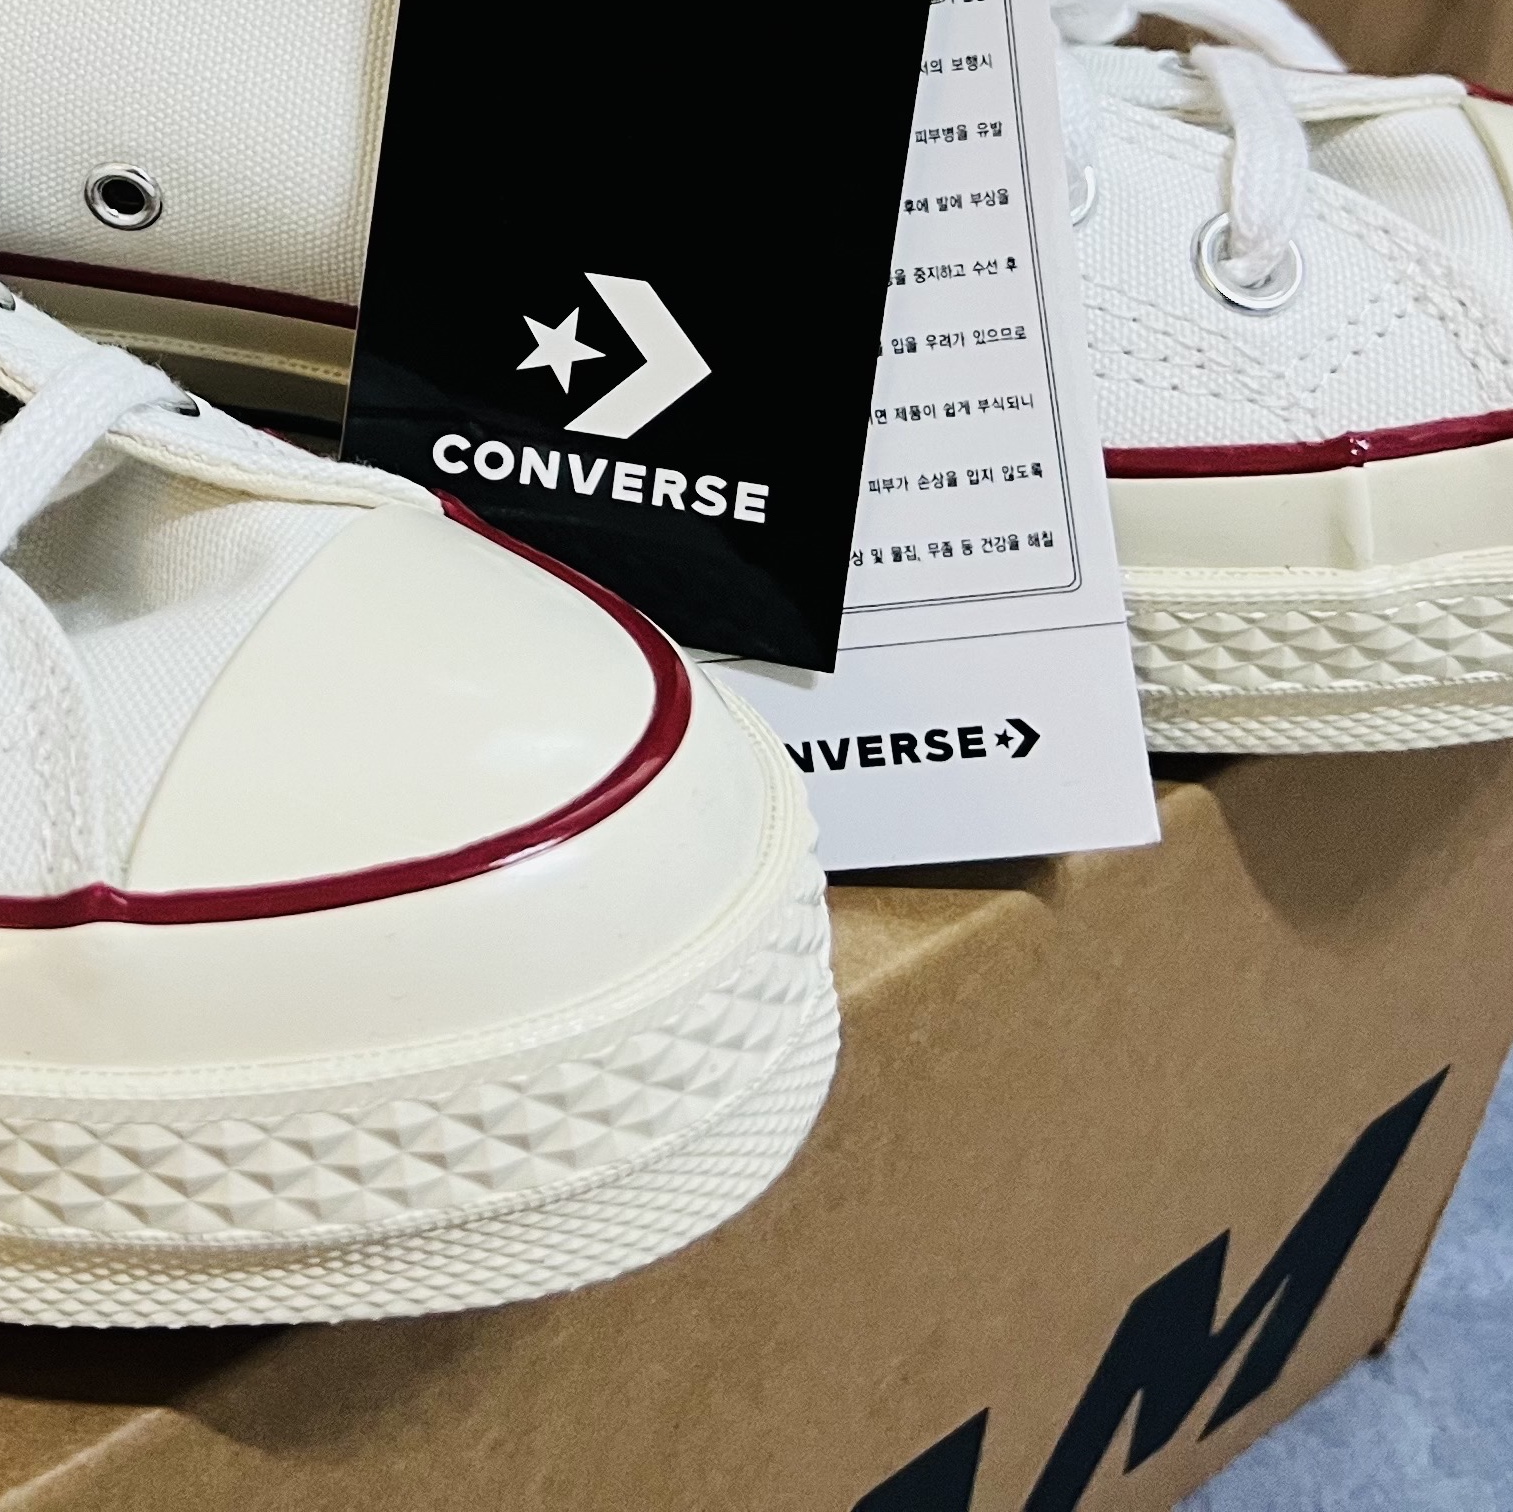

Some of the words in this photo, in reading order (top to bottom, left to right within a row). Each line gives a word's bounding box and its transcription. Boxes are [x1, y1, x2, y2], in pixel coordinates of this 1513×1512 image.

[951, 53, 993, 73] 보행시
[915, 124, 969, 144] 피부병을
[976, 121, 1003, 138] 유발
[903, 197, 929, 215] 후에
[887, 268, 906, 287] 을
[913, 264, 966, 284] 중지하고
[973, 259, 998, 276] 수선
[1006, 256, 1018, 273] 후
[891, 336, 918, 354] 입을
[925, 331, 965, 351] 우려가
[973, 325, 1027, 346] 있으므로
[895, 404, 937, 422] 제품이
[943, 400, 971, 418] 쉽게
[977, 393, 1034, 414] 부식되니
[432, 434, 769, 524] CONVERSE
[868, 476, 909, 495] 피부가
[918, 470, 958, 491] 손상을
[966, 467, 994, 485] 입지
[1002, 462, 1043, 482] 않도록
[870, 548, 884, 565] 및
[891, 544, 921, 563] 물집,
[928, 541, 954, 558] 무좀
[961, 540, 973, 557] 등
[981, 534, 1020, 554] 건강을
[1027, 530, 1054, 548] 해칠
